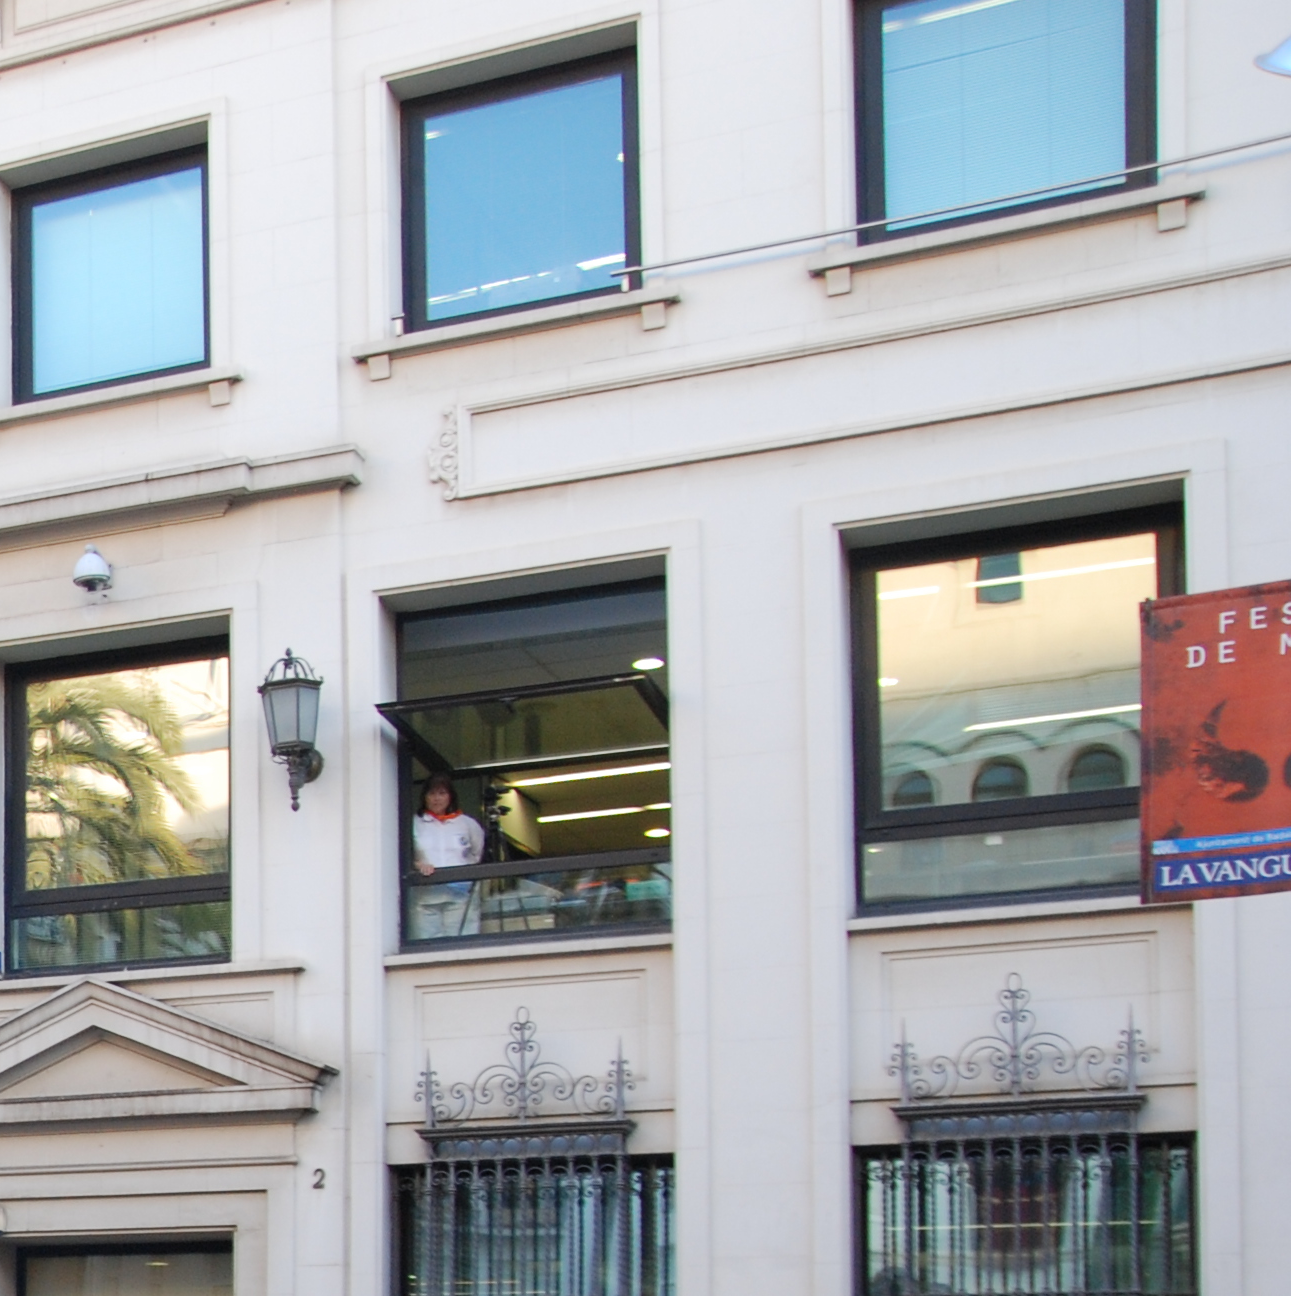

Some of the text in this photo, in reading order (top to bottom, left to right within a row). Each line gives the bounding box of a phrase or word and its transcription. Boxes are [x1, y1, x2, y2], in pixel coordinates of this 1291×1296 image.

[1185, 640, 1236, 669] DE
[1160, 863, 1199, 887] LA
[312, 1168, 326, 1190] 2
